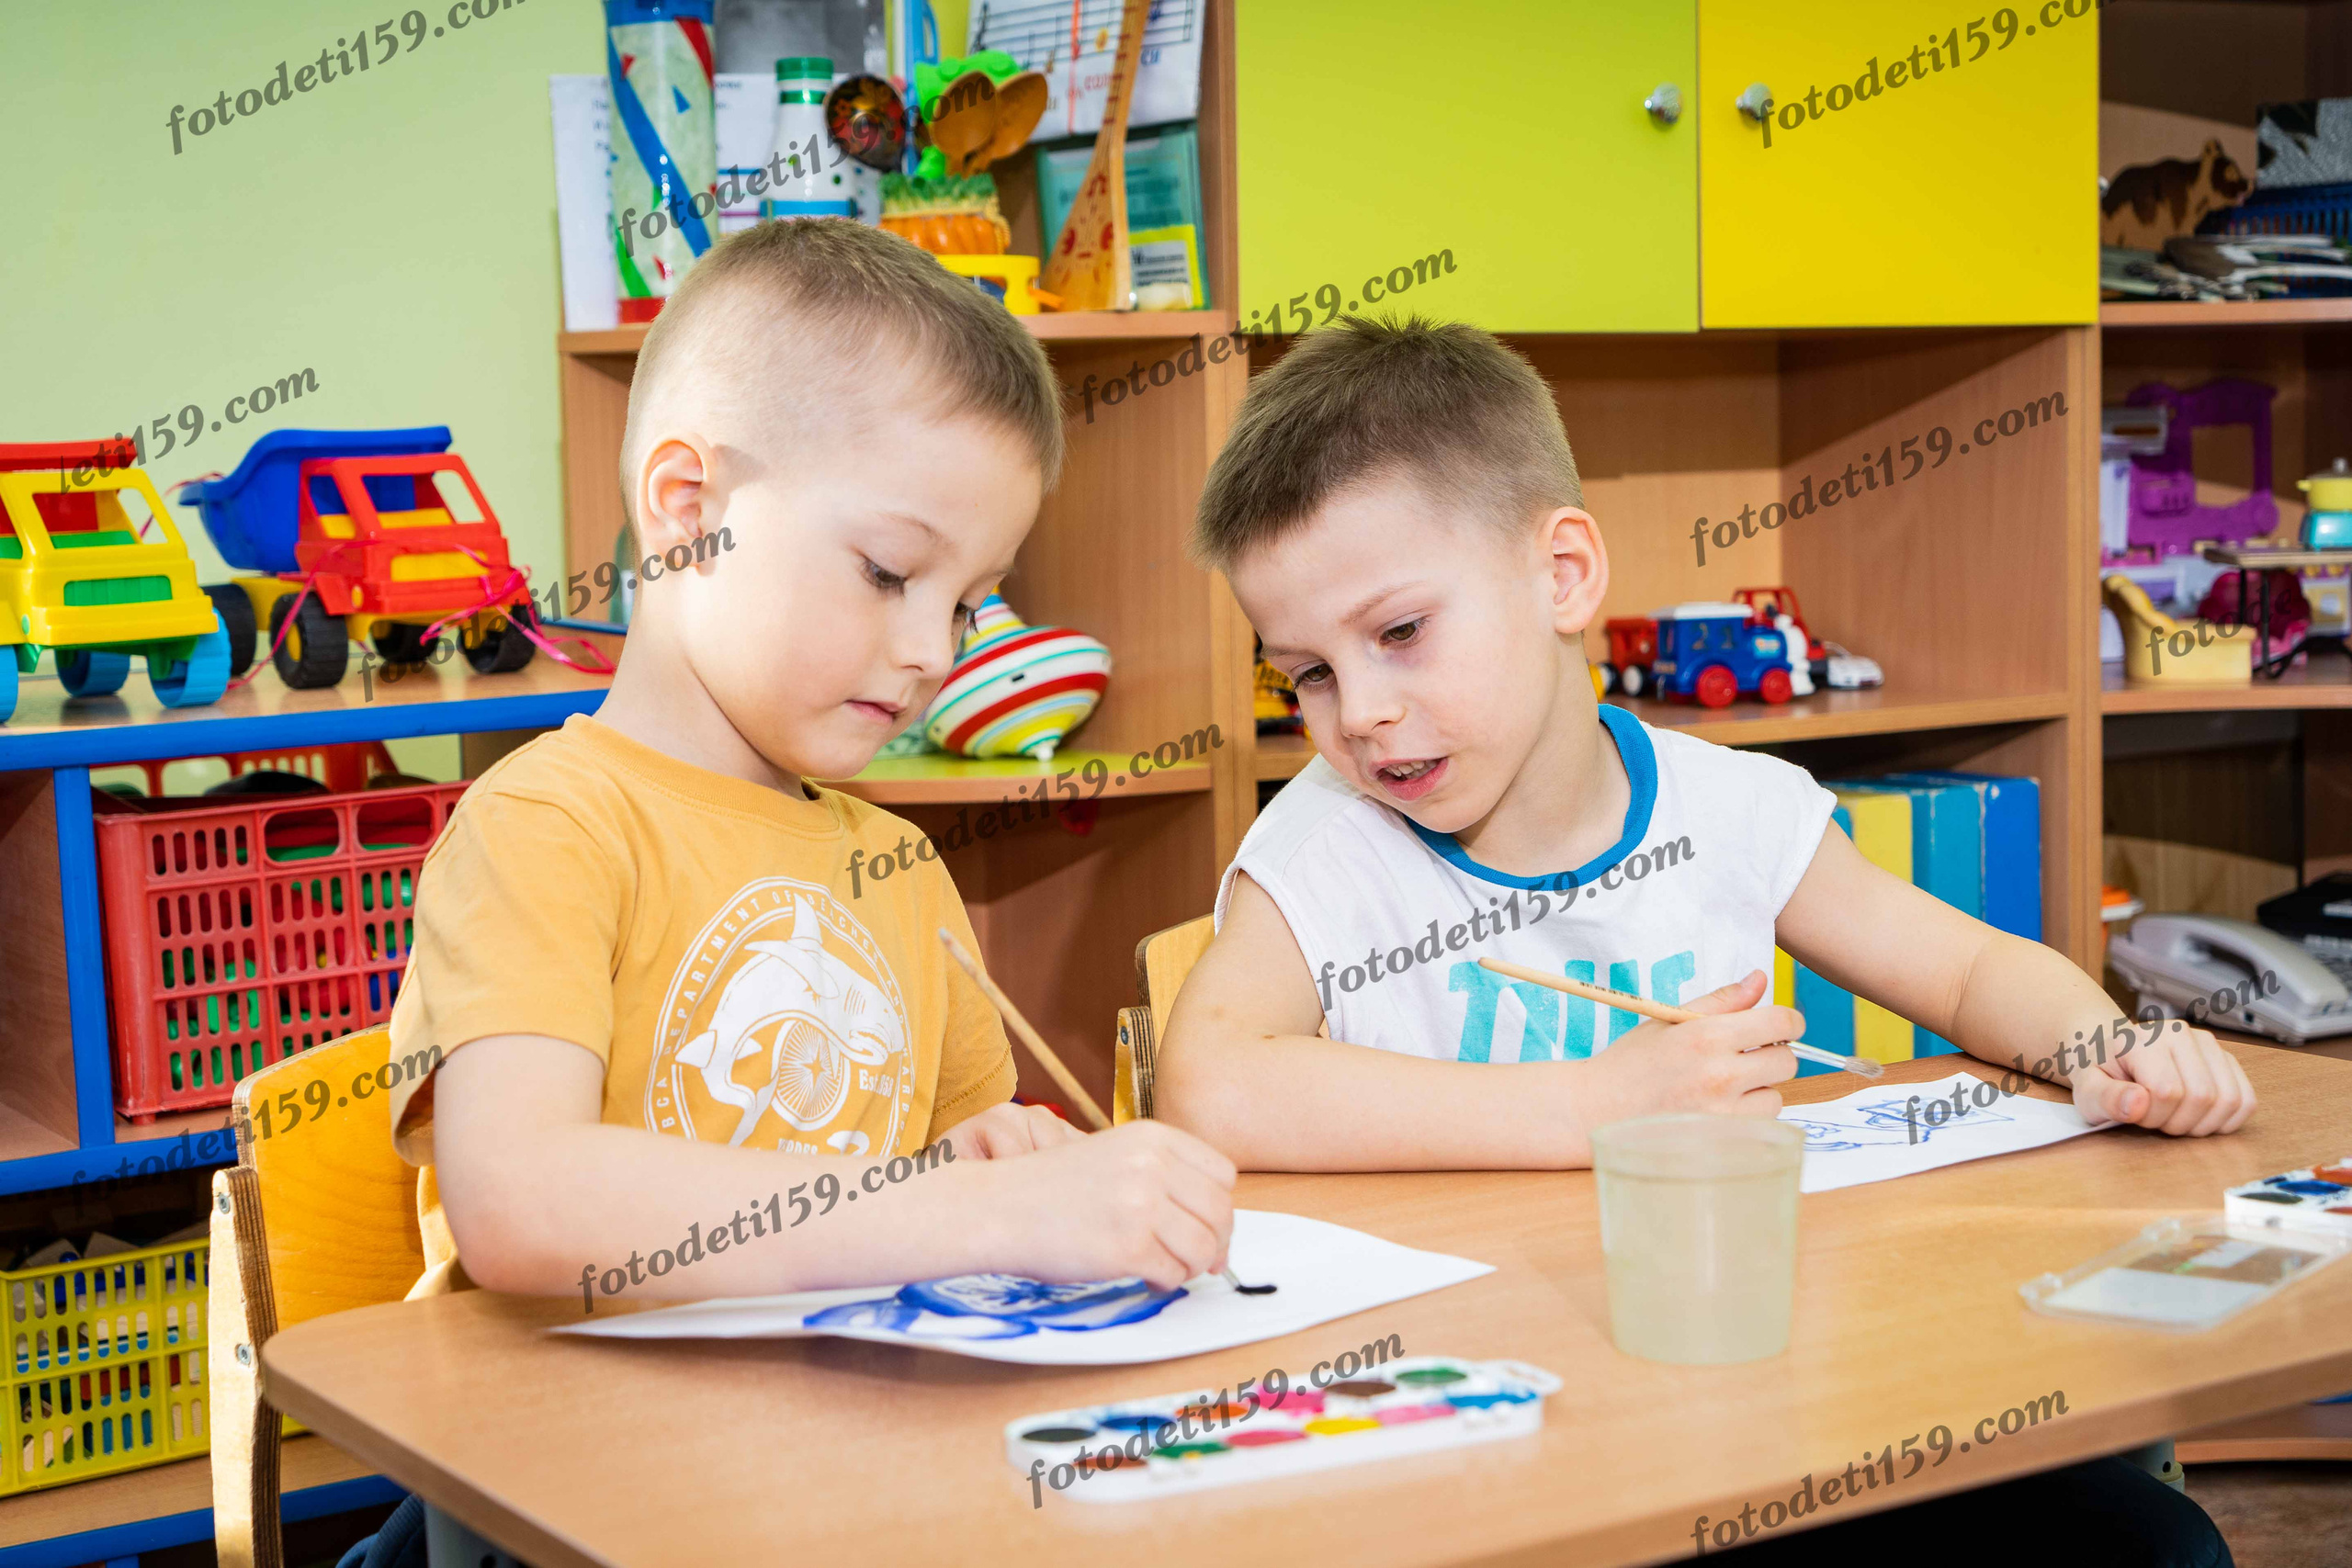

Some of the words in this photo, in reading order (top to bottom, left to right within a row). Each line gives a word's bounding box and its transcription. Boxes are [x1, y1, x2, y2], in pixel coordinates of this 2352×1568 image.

[772, 889, 792, 904] OF
[661, 897, 761, 1055] DEPARTMENT
[655, 1077, 675, 1129] BCA
